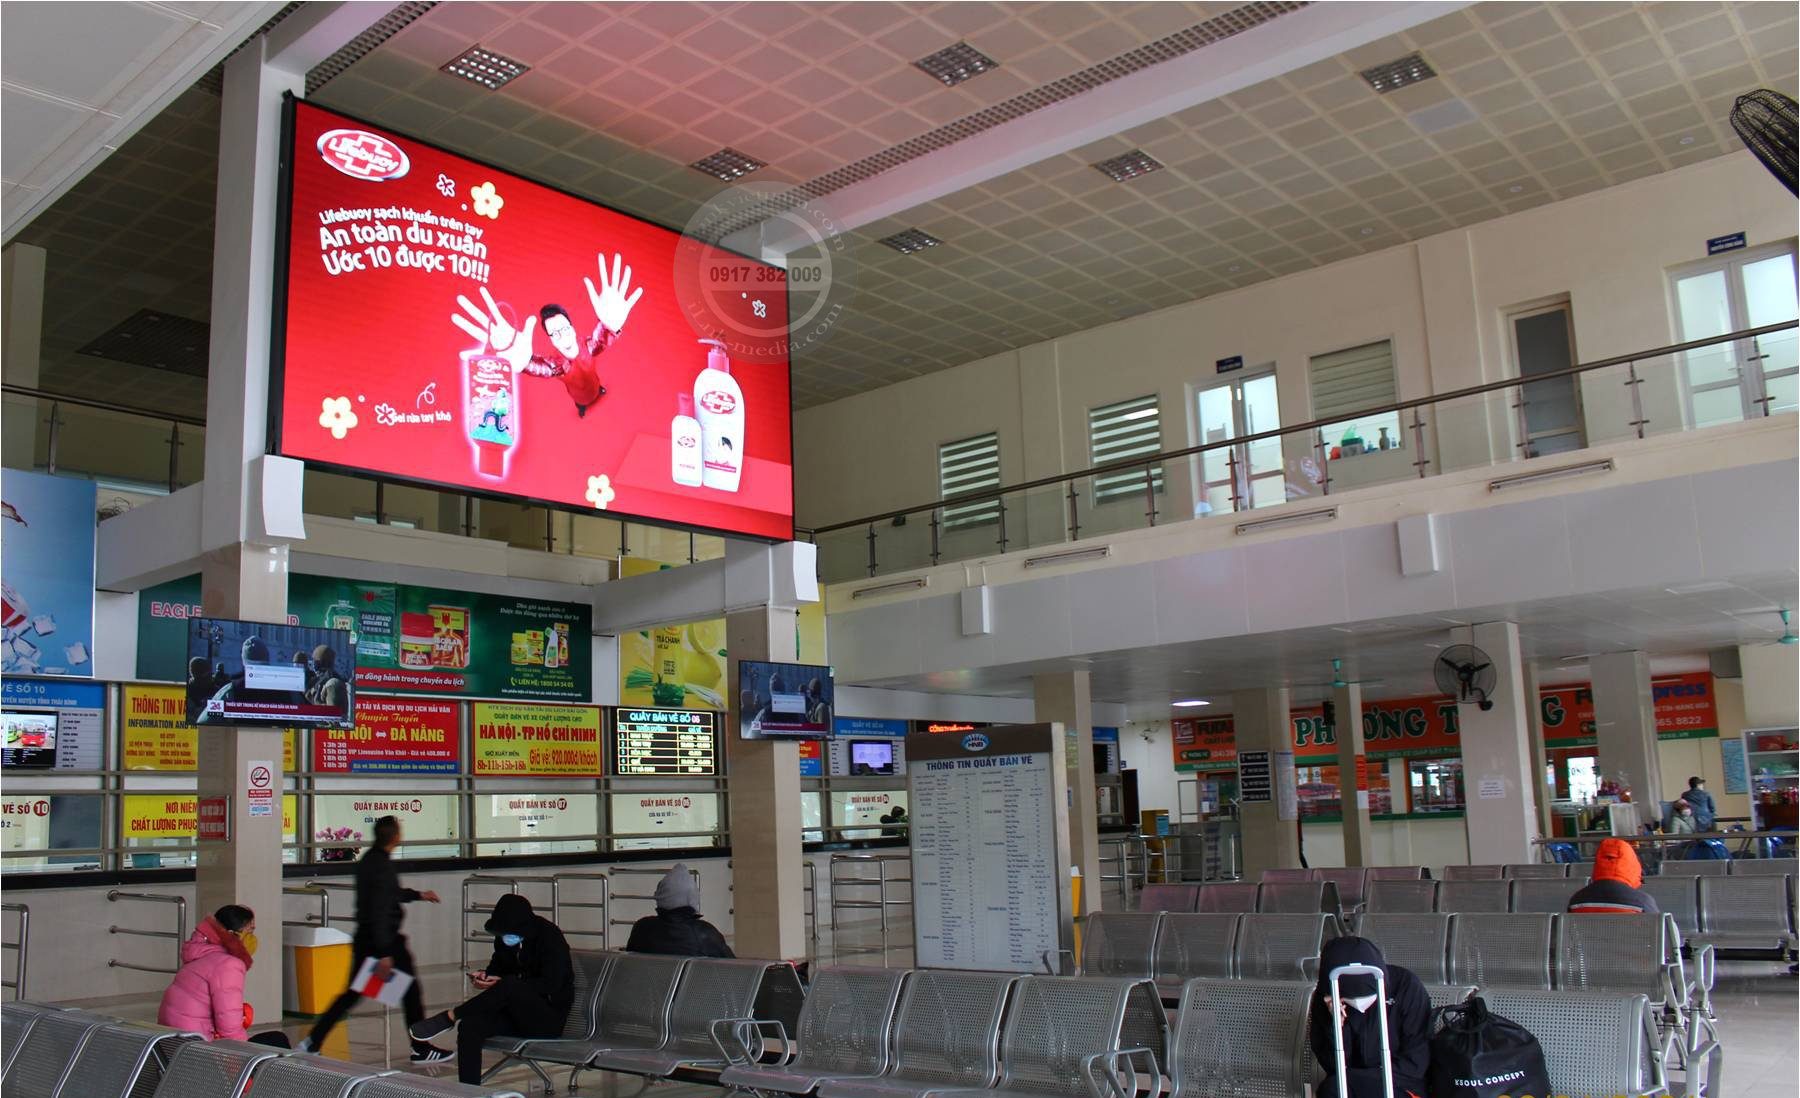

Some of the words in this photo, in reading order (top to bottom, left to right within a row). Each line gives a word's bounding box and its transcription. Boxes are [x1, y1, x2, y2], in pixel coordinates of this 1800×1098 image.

[328, 137, 399, 171] Lifebuoy
[319, 207, 372, 225] Lifebuoy
[373, 206, 400, 220] sạch
[439, 215, 463, 231] trên
[464, 222, 484, 239] tay
[319, 227, 352, 250] An
[351, 221, 403, 243] toàn
[406, 222, 433, 245] du
[436, 235, 488, 260] xuân
[321, 250, 366, 276] Ước
[365, 246, 392, 268] 10
[395, 244, 445, 273] được
[448, 254, 490, 283] 10!!!
[151, 602, 202, 619] EAGLE
[365, 673, 382, 682] đồng
[383, 674, 400, 682] hành
[401, 676, 419, 684] trong
[420, 675, 443, 686] chuyến
[453, 678, 464, 686] lịch
[16, 683, 31, 693] SỐ
[34, 686, 45, 694] 10
[1652, 683, 1706, 701] press
[132, 694, 159, 713] THÔNG
[162, 699, 175, 715] TIN
[362, 702, 372, 711] TẢI
[382, 704, 395, 712] DỊCH
[397, 704, 404, 712] VỤ
[415, 705, 427, 713] LỊCH
[128, 719, 173, 728] INFORMATION
[653, 712, 667, 722] BÁN
[669, 712, 678, 722] VÉ
[680, 712, 691, 723] SỐ
[351, 724, 372, 743] NỘI
[390, 725, 407, 742] ĐÀ
[480, 722, 496, 739] HÀ
[498, 722, 516, 742] NỘI
[522, 726, 535, 740] TP
[571, 728, 596, 742] MINH
[530, 748, 540, 765] Giá
[926, 760, 955, 771] THÔNG
[957, 760, 970, 769] TIN
[973, 757, 998, 769] QUẦY
[999, 755, 1018, 766] BÁN
[1021, 755, 1033, 765] VÉ
[3, 802, 15, 814] VÉ
[18, 801, 31, 815] SỐ
[36, 803, 48, 815] 10
[165, 800, 178, 814] NƠI
[390, 800, 398, 810] VÉ
[400, 800, 409, 811] SỐ
[540, 799, 547, 808] VÉ
[548, 798, 557, 808] SỐ
[132, 815, 151, 831] CHẤT
[152, 818, 177, 834] LƯỢNG
[178, 818, 197, 833] PHỤC
[1485, 1071, 1525, 1085] CONCEPT
